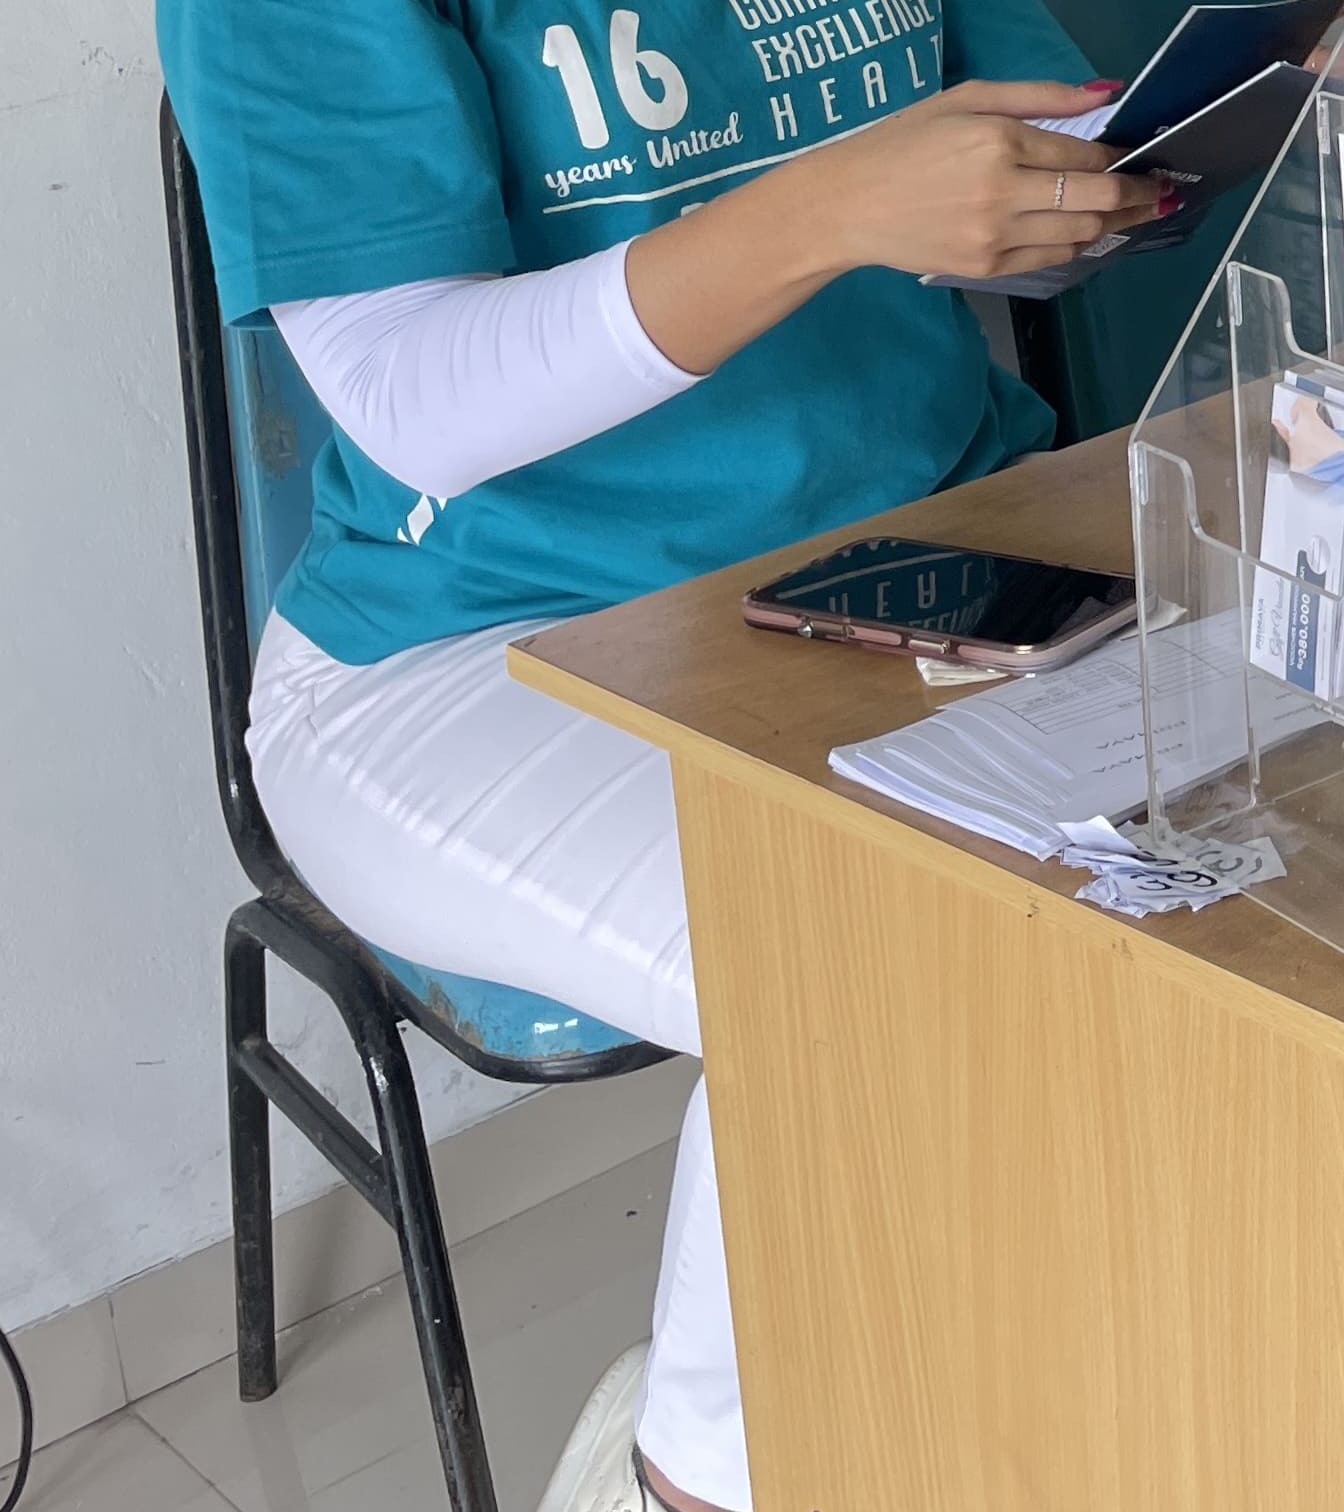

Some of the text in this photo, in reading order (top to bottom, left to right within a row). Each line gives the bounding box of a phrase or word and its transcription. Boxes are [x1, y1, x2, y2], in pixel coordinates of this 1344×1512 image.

[542, 9, 689, 150] 16
[545, 111, 744, 198] years United
